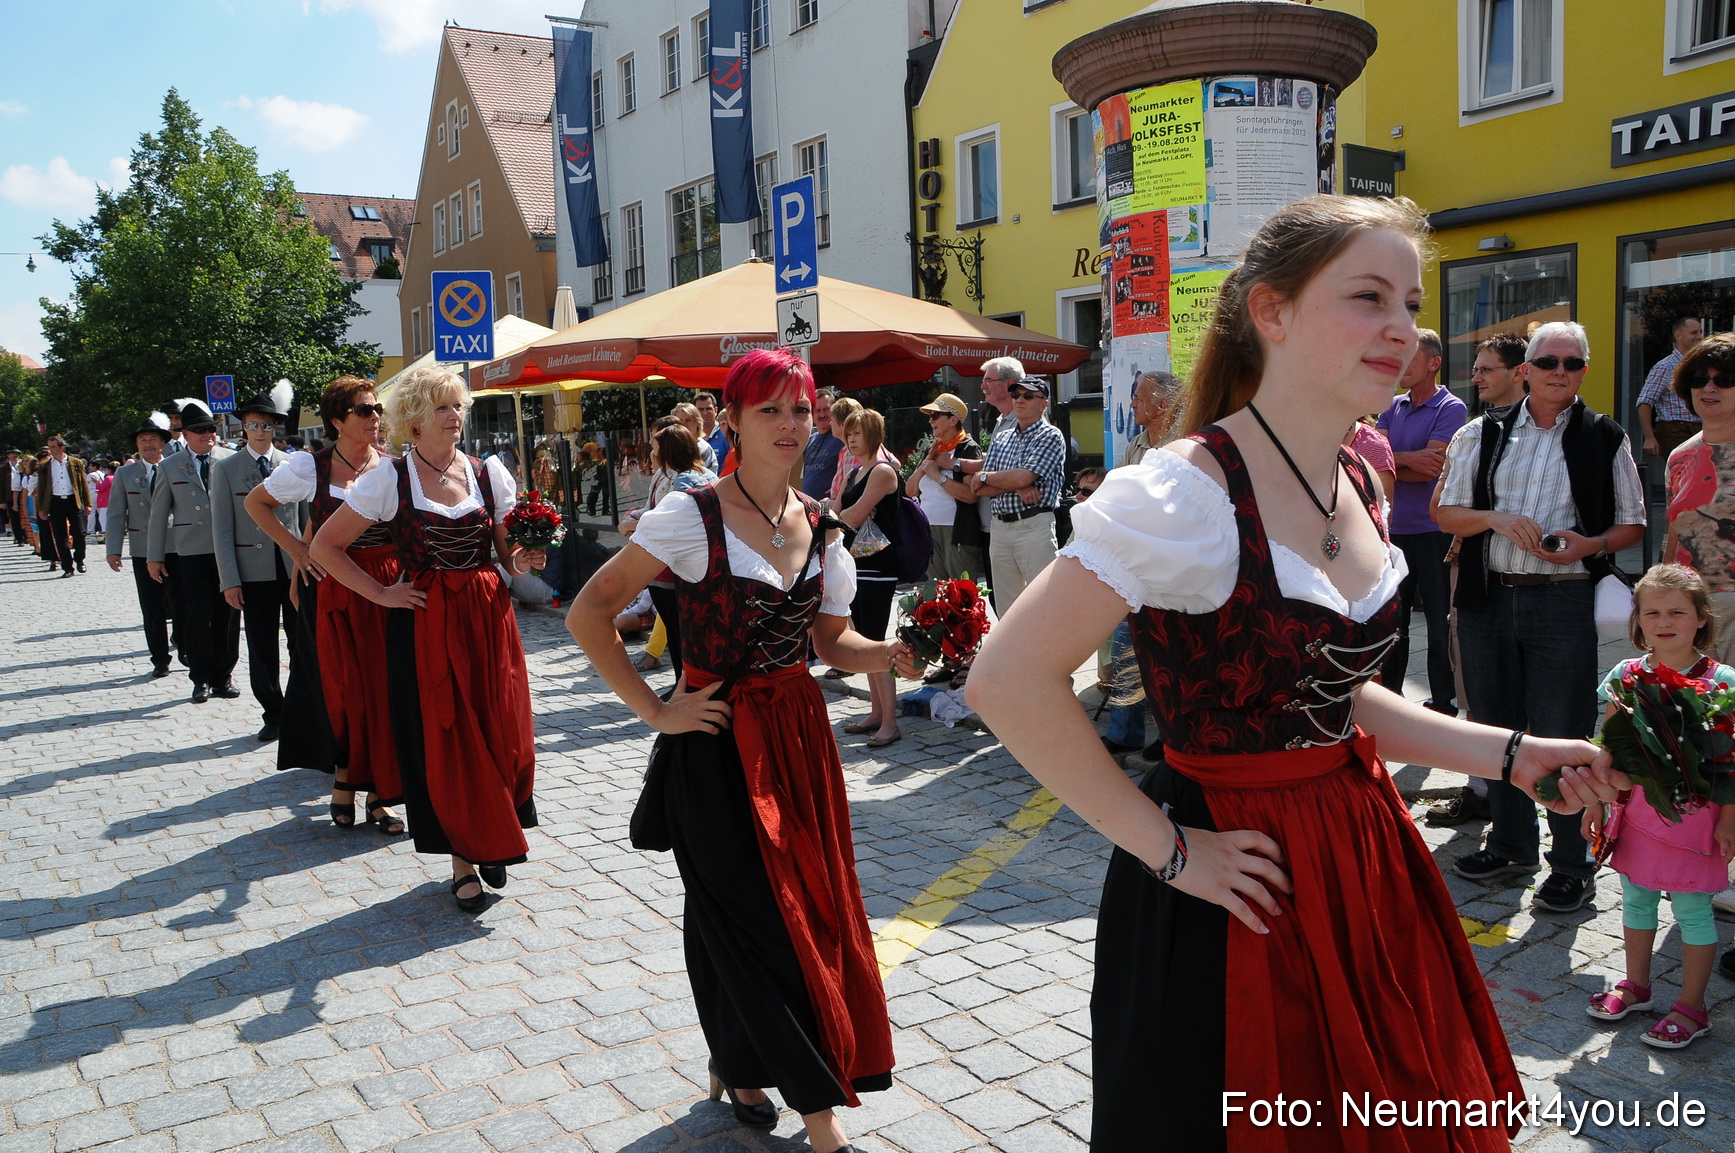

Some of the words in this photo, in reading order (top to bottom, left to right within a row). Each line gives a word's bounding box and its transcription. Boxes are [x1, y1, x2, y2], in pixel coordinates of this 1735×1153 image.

[712, 31, 744, 118] K&L
[1130, 96, 1195, 115] Neumarkter
[1142, 111, 1181, 126] JURA-
[1236, 115, 1304, 126] Sonntagsführungen
[1612, 98, 1735, 155] TAIF
[1236, 126, 1248, 134] für
[1250, 126, 1291, 135] Jedermann
[1292, 128, 1307, 136] 2013
[1148, 149, 1160, 157] dem
[1161, 146, 1190, 156] Festplatz
[1142, 156, 1170, 166] Neumarkt
[1350, 177, 1393, 194] TAIFUN
[1170, 194, 1198, 203] NEUMARKT
[781, 191, 805, 256] P
[1153, 214, 1166, 258] Kultur
[1072, 247, 1101, 278] Re
[1182, 274, 1196, 282] zum
[790, 300, 804, 311] nur
[440, 334, 488, 354] TAXI
[547, 355, 563, 368] Hotel
[563, 352, 592, 365] Restaurant
[925, 345, 950, 356] Hotel
[952, 346, 1001, 357] Restaurant
[1003, 345, 1059, 363] Lehmeier
[211, 401, 233, 411] TAXI
